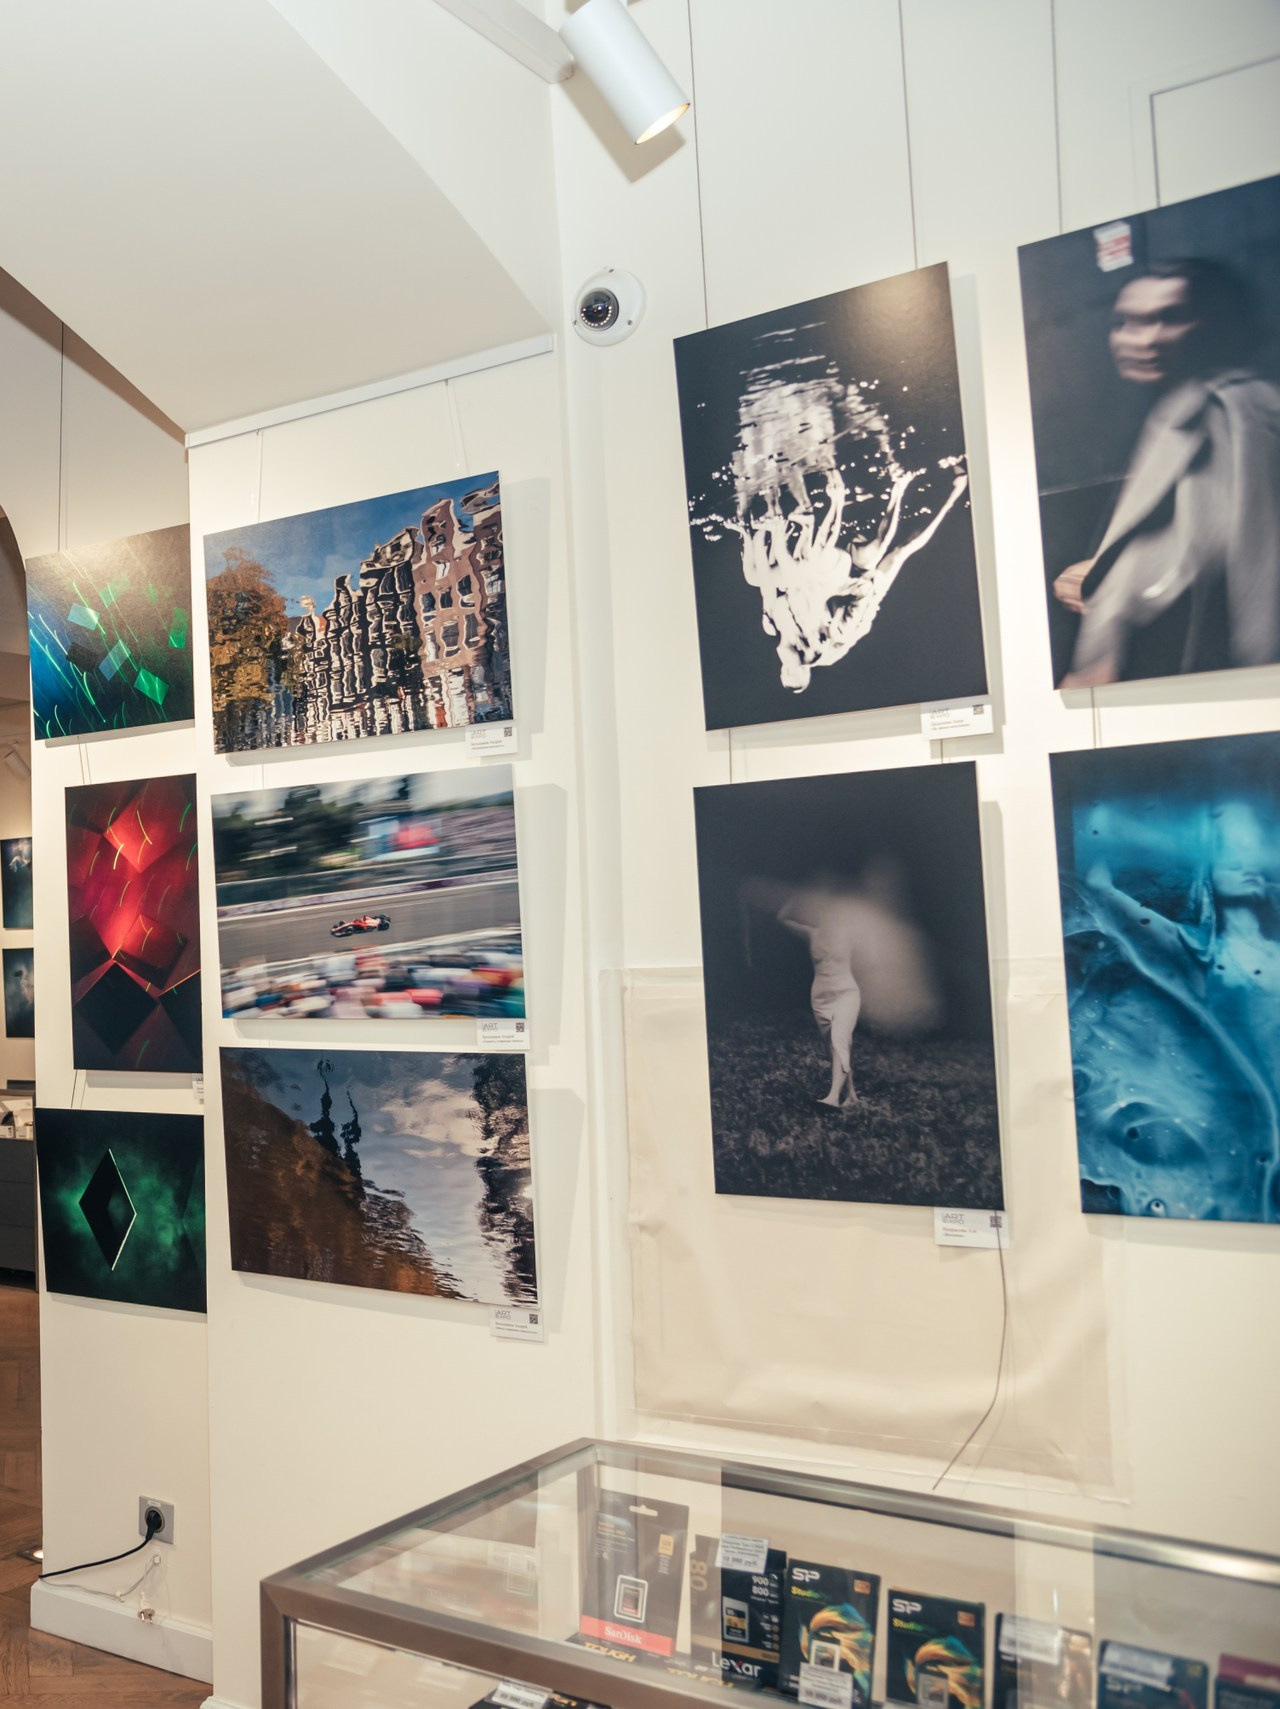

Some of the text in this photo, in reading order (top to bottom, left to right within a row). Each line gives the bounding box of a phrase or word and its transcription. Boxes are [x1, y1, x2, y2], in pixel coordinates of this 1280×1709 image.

[752, 1575, 769, 1586] 900
[791, 1567, 820, 1582] SP
[892, 1599, 922, 1614] SP
[604, 1626, 643, 1645] SanDisk
[711, 1651, 762, 1677] Lexar
